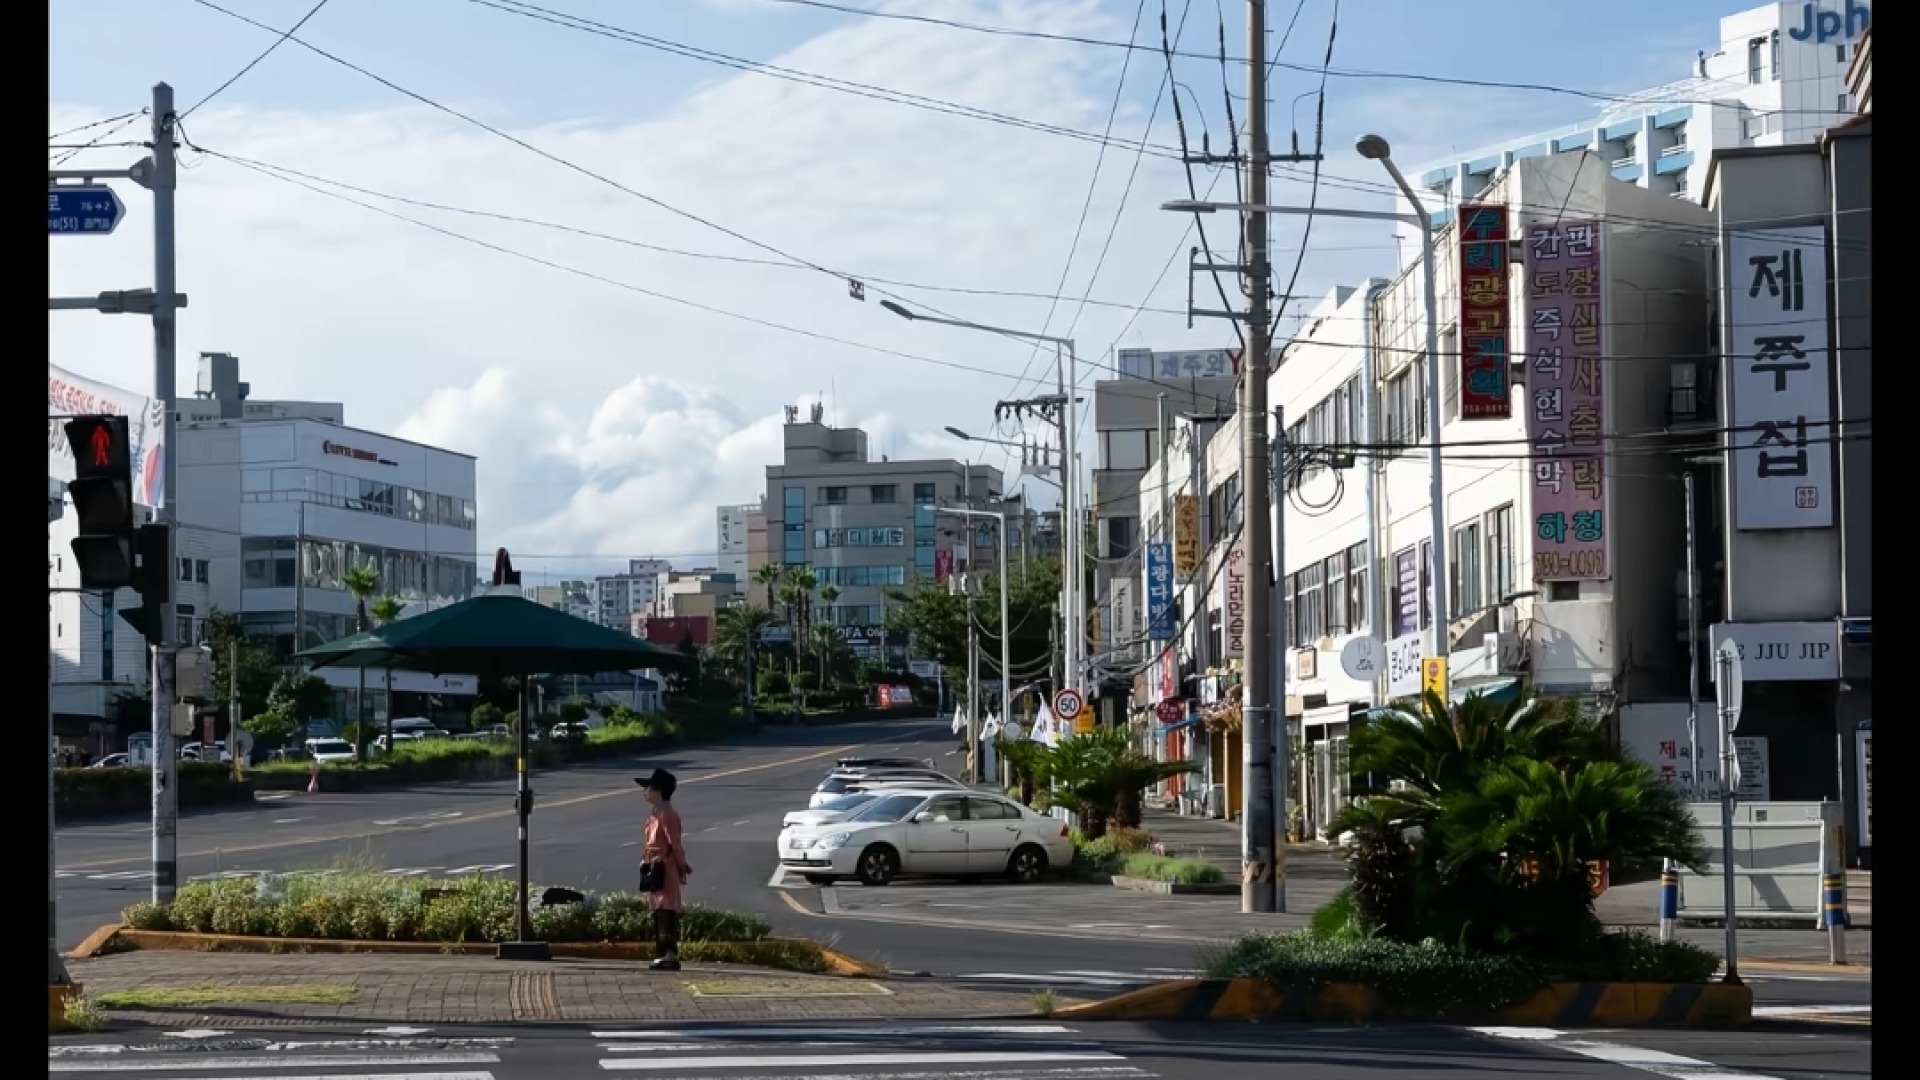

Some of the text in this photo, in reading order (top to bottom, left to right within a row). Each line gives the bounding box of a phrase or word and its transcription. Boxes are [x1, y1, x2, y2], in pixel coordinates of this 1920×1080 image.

[1754, 643, 1790, 660] JJU
[1799, 642, 1830, 660] JIP
[1060, 697, 1077, 712] 50
